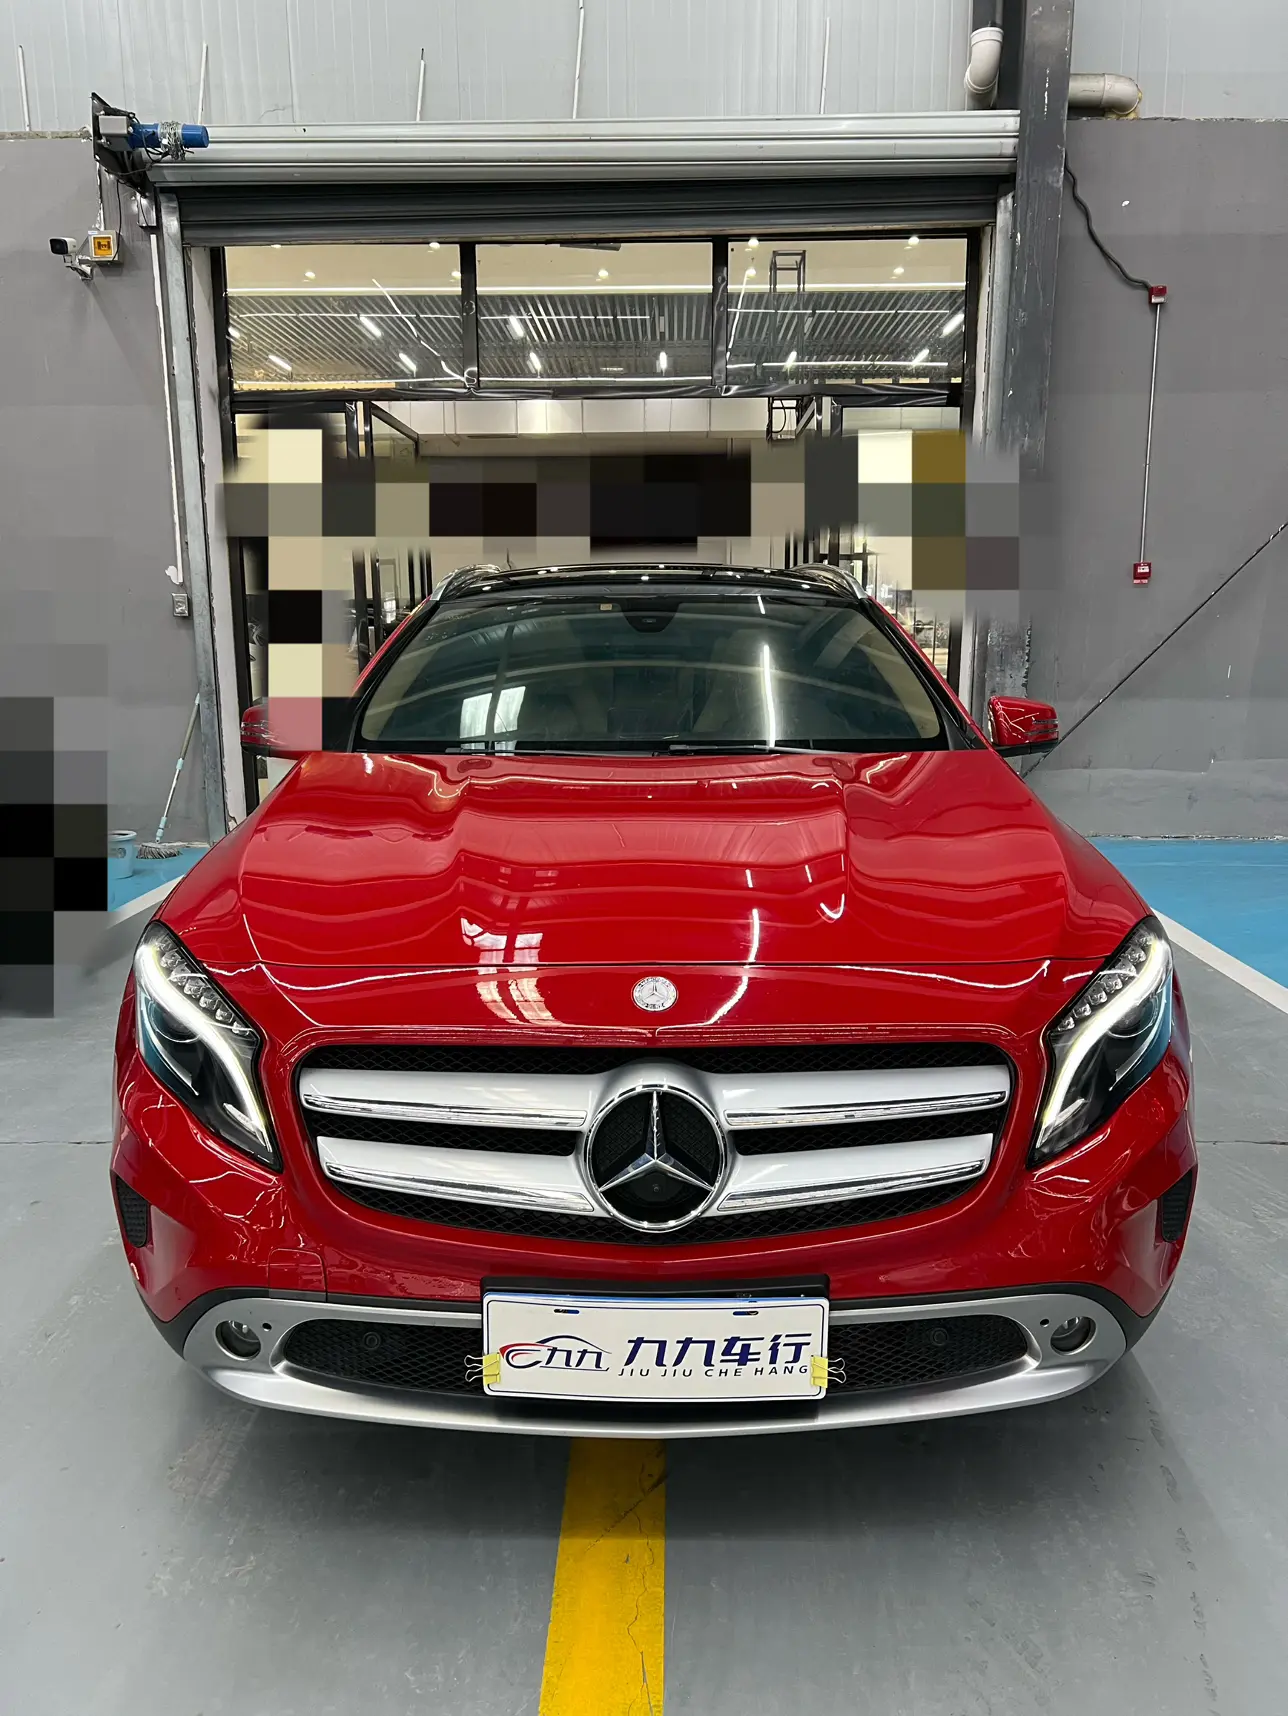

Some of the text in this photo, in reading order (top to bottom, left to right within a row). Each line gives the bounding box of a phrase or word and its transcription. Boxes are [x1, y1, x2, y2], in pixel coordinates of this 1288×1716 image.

[623, 1333, 812, 1367] 九九车行
[618, 1365, 808, 1378] JIU JIU CHE HANG
